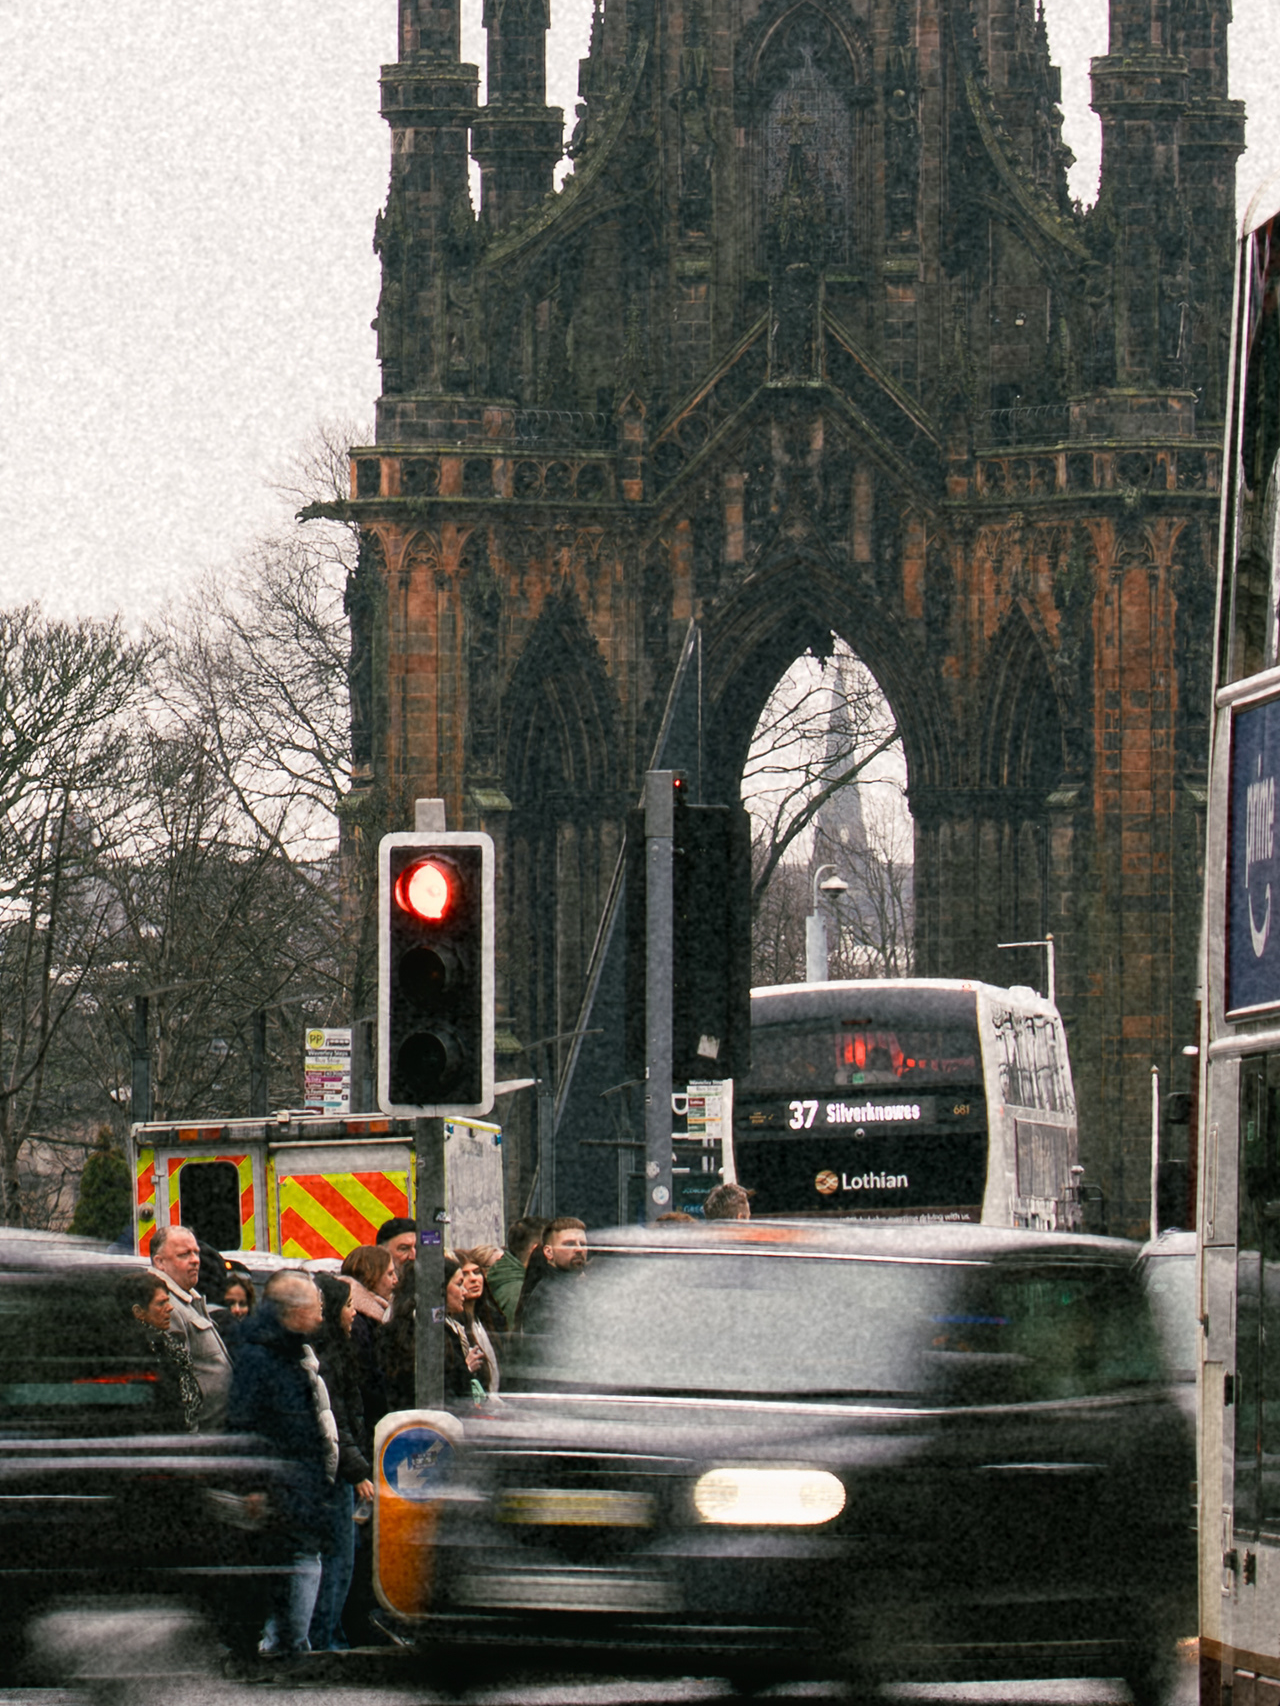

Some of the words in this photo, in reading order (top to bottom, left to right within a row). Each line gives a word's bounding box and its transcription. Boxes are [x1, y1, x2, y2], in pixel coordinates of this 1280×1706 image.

[1245, 753, 1275, 889] prime
[789, 1099, 819, 1130] 37
[826, 1102, 921, 1124] Silverknowes
[953, 1104, 970, 1115] 681
[842, 1171, 909, 1191] Lothian
[944, 1212, 961, 1222] with
